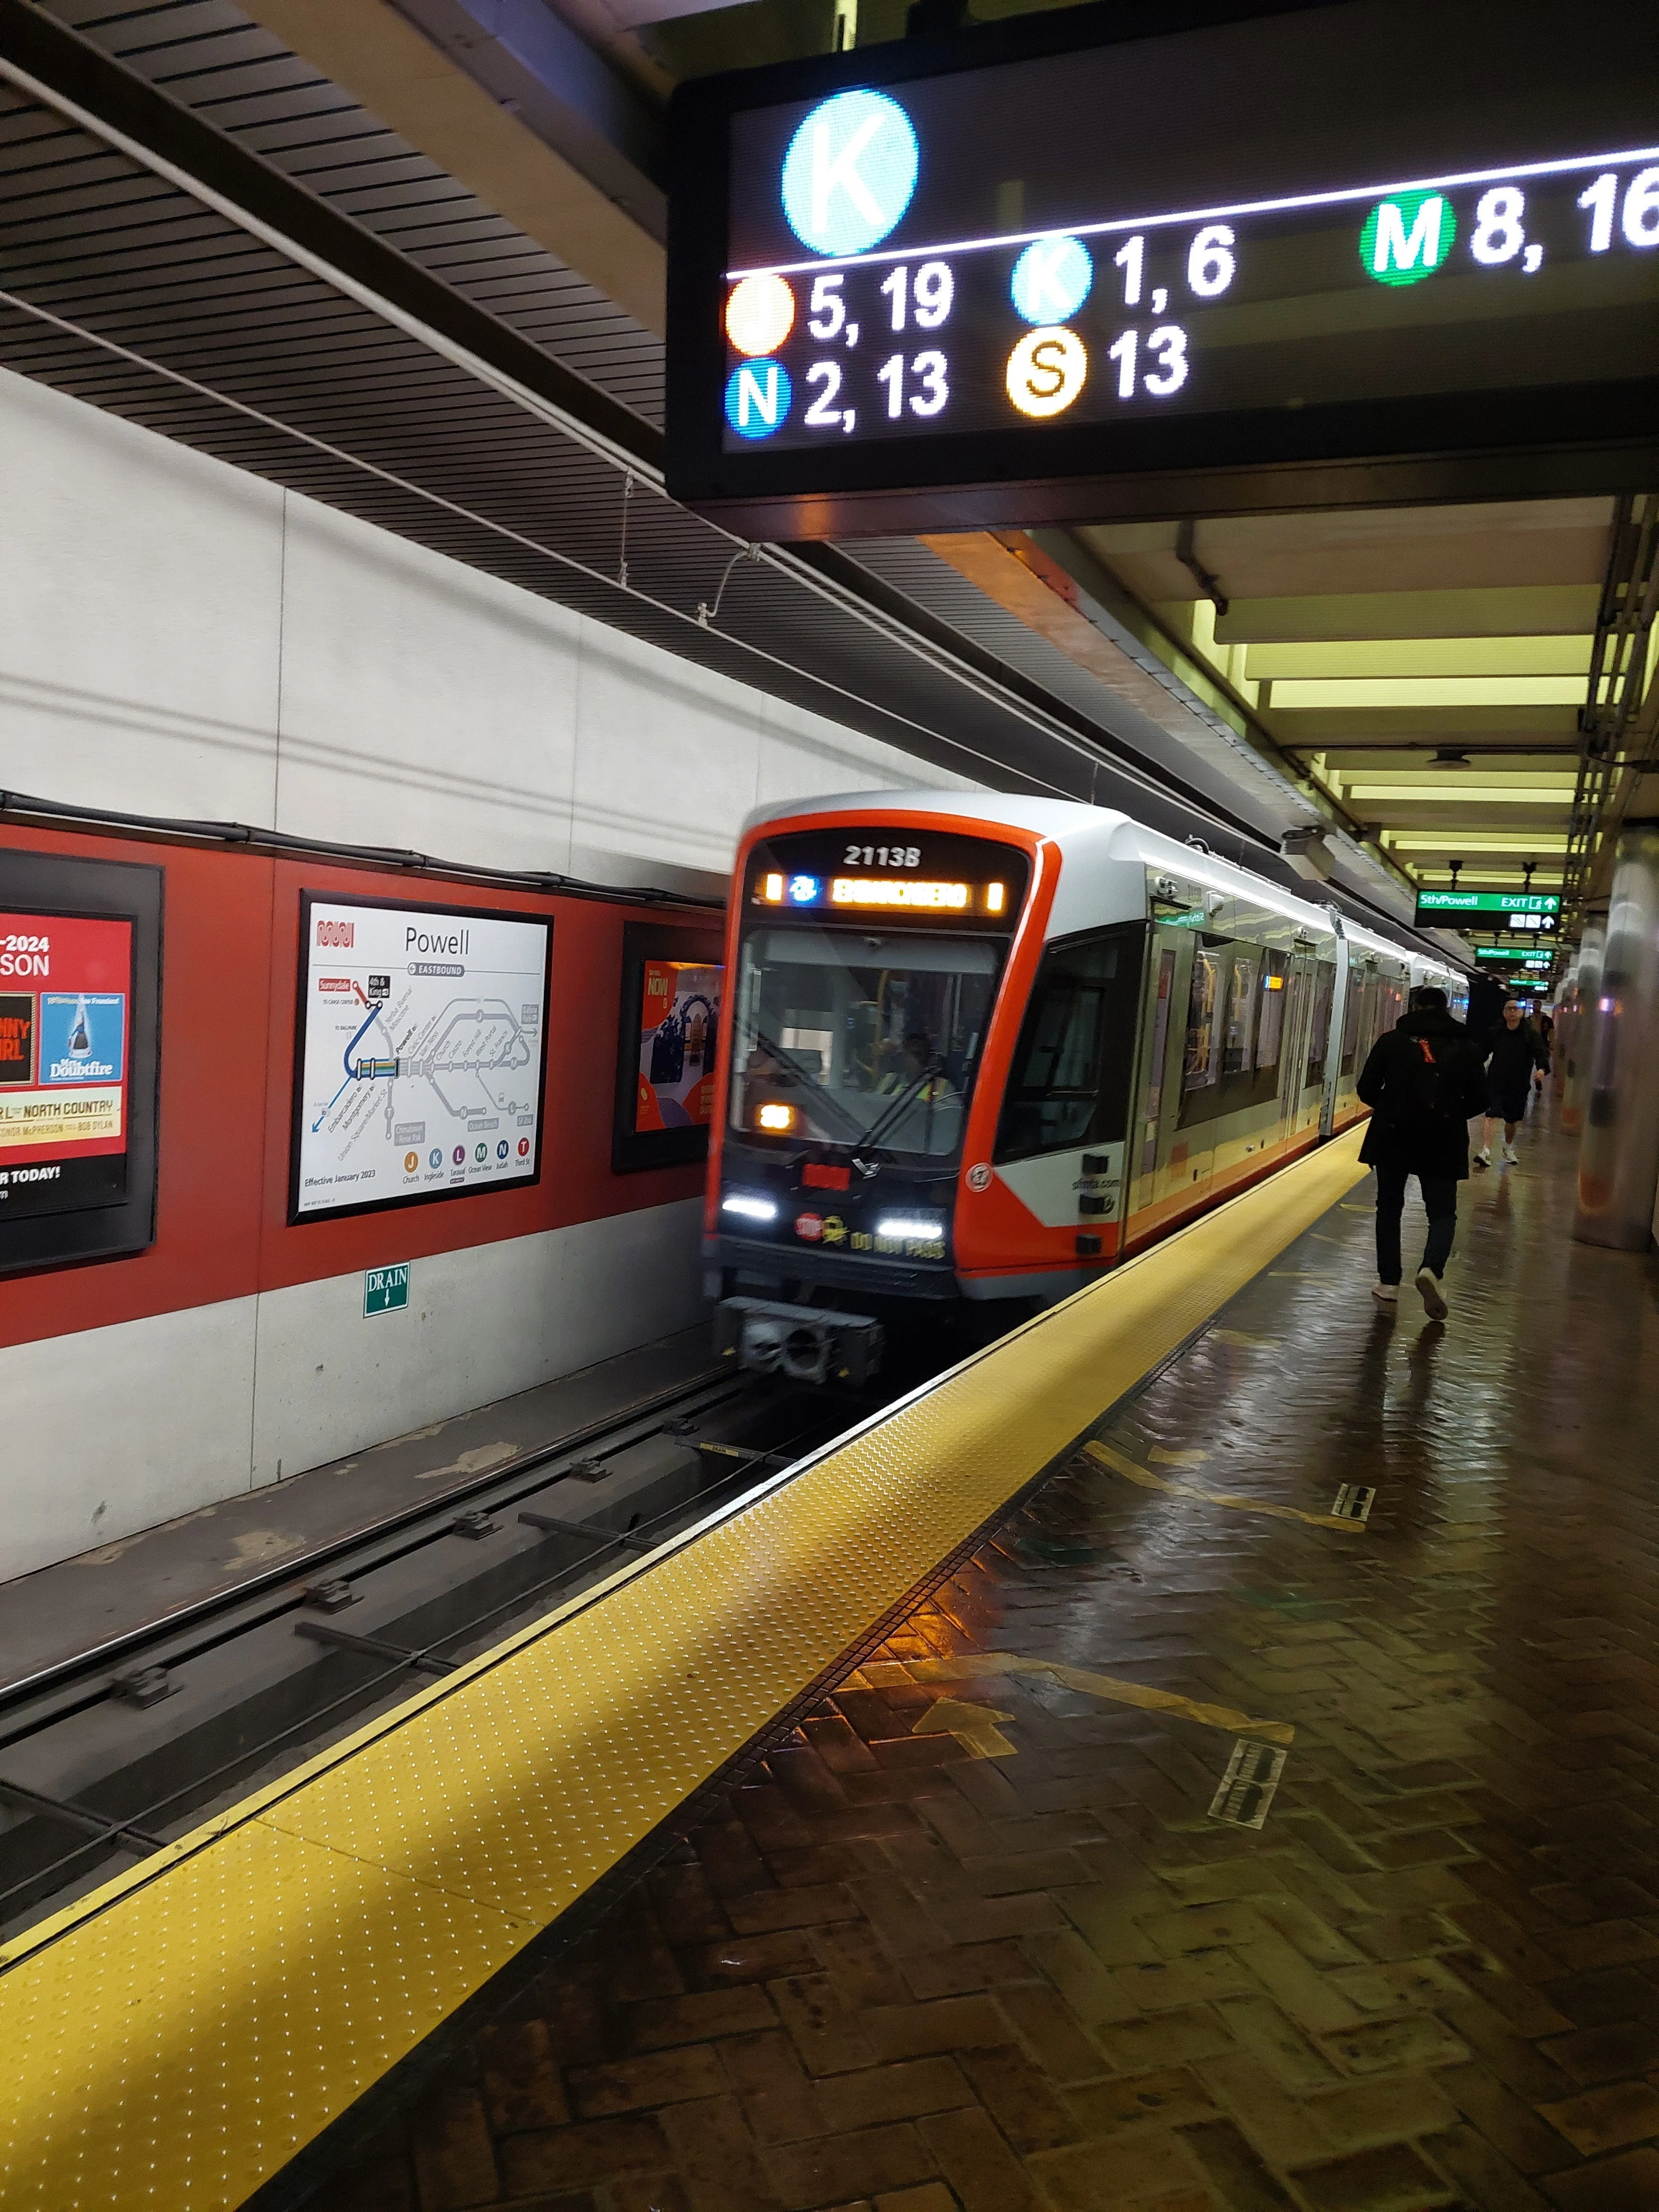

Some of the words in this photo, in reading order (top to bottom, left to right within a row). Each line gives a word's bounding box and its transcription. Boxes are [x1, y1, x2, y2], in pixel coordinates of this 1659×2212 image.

[813, 115, 885, 233] K
[1373, 197, 1443, 273] M
[1471, 186, 1543, 273] 8,
[1028, 246, 1073, 312] K
[1114, 235, 1169, 314] 1,
[1188, 225, 1236, 296] 6
[807, 274, 859, 349] 5,
[880, 261, 955, 332] 19
[1025, 340, 1067, 398] S
[1107, 325, 1189, 400] 13
[738, 366, 777, 427] N
[804, 361, 856, 434] 2,
[877, 350, 950, 419] 13
[843, 845, 921, 867] 2113B
[1501, 897, 1528, 907] EXIT
[406, 927, 469, 955] Powell
[419, 965, 462, 975] EASTBOUND
[49, 1061, 113, 1077] Doubtfire
[23, 1103, 61, 1118] NORTH
[63, 1100, 113, 1115] COUNTRY
[476, 1146, 486, 1159] M
[499, 1143, 507, 1156] N
[11, 1166, 61, 1184] TODAY!
[304, 1177, 333, 1188] Effective
[334, 1172, 359, 1182] January
[360, 1169, 376, 1179] 2023
[368, 1267, 408, 1293] DRAIN
